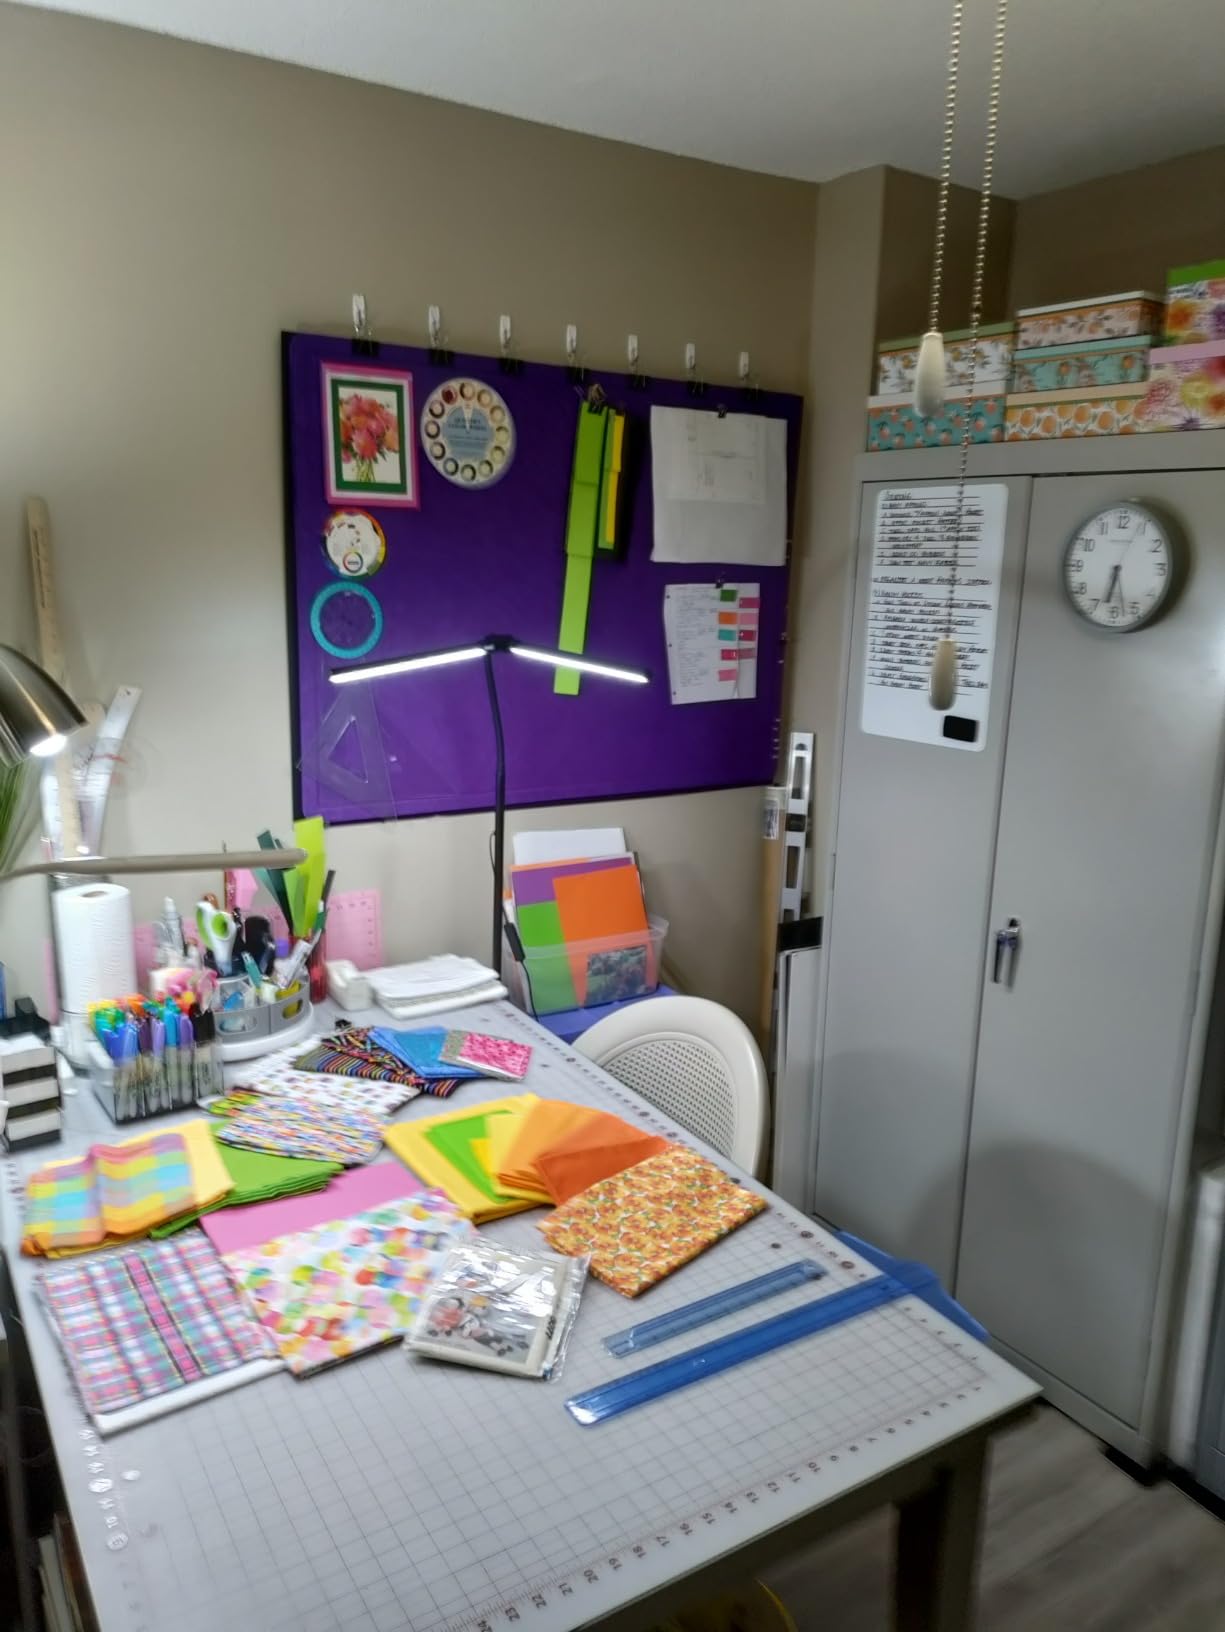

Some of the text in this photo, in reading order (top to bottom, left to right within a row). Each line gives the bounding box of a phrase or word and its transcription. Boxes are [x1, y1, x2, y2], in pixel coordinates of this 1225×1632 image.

[1099, 520, 1109, 536] 11
[1118, 515, 1130, 529] 12
[1081, 539, 1096, 552] 10
[1150, 539, 1162, 553] 2
[1072, 560, 1084, 572] 9
[1155, 562, 1168, 577] 3
[1074, 582, 1087, 595] 8
[1089, 598, 1100, 611] 7
[1128, 601, 1140, 615] 5
[1108, 606, 1119, 619] 6
[808, 1461, 821, 1473] 10
[787, 1472, 800, 1483] 11
[767, 1481, 780, 1493] 12
[746, 1491, 759, 1503] 13
[702, 1512, 716, 1525] 15
[680, 1522, 693, 1536] 16
[656, 1535, 670, 1548] 17
[632, 1545, 647, 1559] 18
[608, 1557, 623, 1571] 19
[583, 1569, 599, 1584] 20
[558, 1582, 574, 1597] 21
[531, 1594, 547, 1609] 22
[505, 1606, 521, 1622] 23
